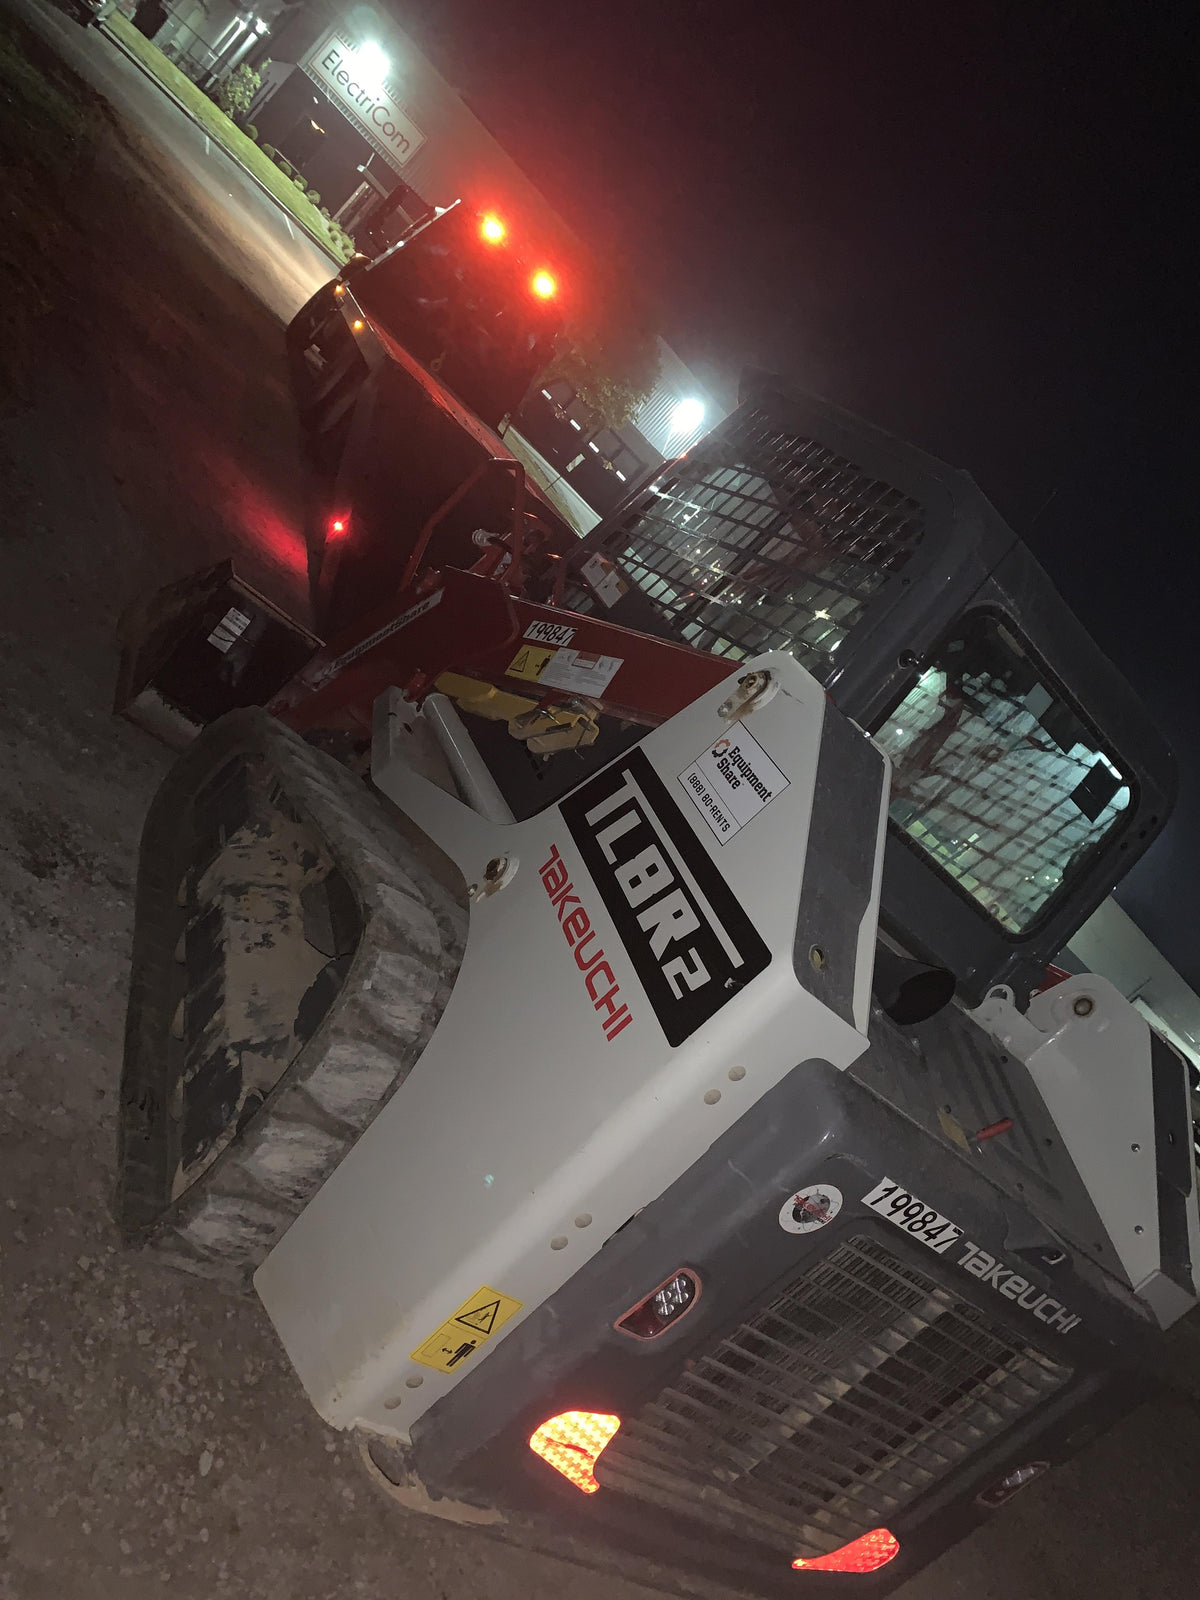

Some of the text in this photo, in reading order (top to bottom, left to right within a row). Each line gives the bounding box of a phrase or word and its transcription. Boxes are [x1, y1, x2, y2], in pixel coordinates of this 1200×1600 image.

[321, 49, 410, 154] ElectriCom
[527, 622, 577, 645] 199847
[687, 772, 706, 796] (888)
[716, 757, 741, 790] Share
[727, 746, 773, 803] Equipment
[869, 1185, 965, 1248] 199847
